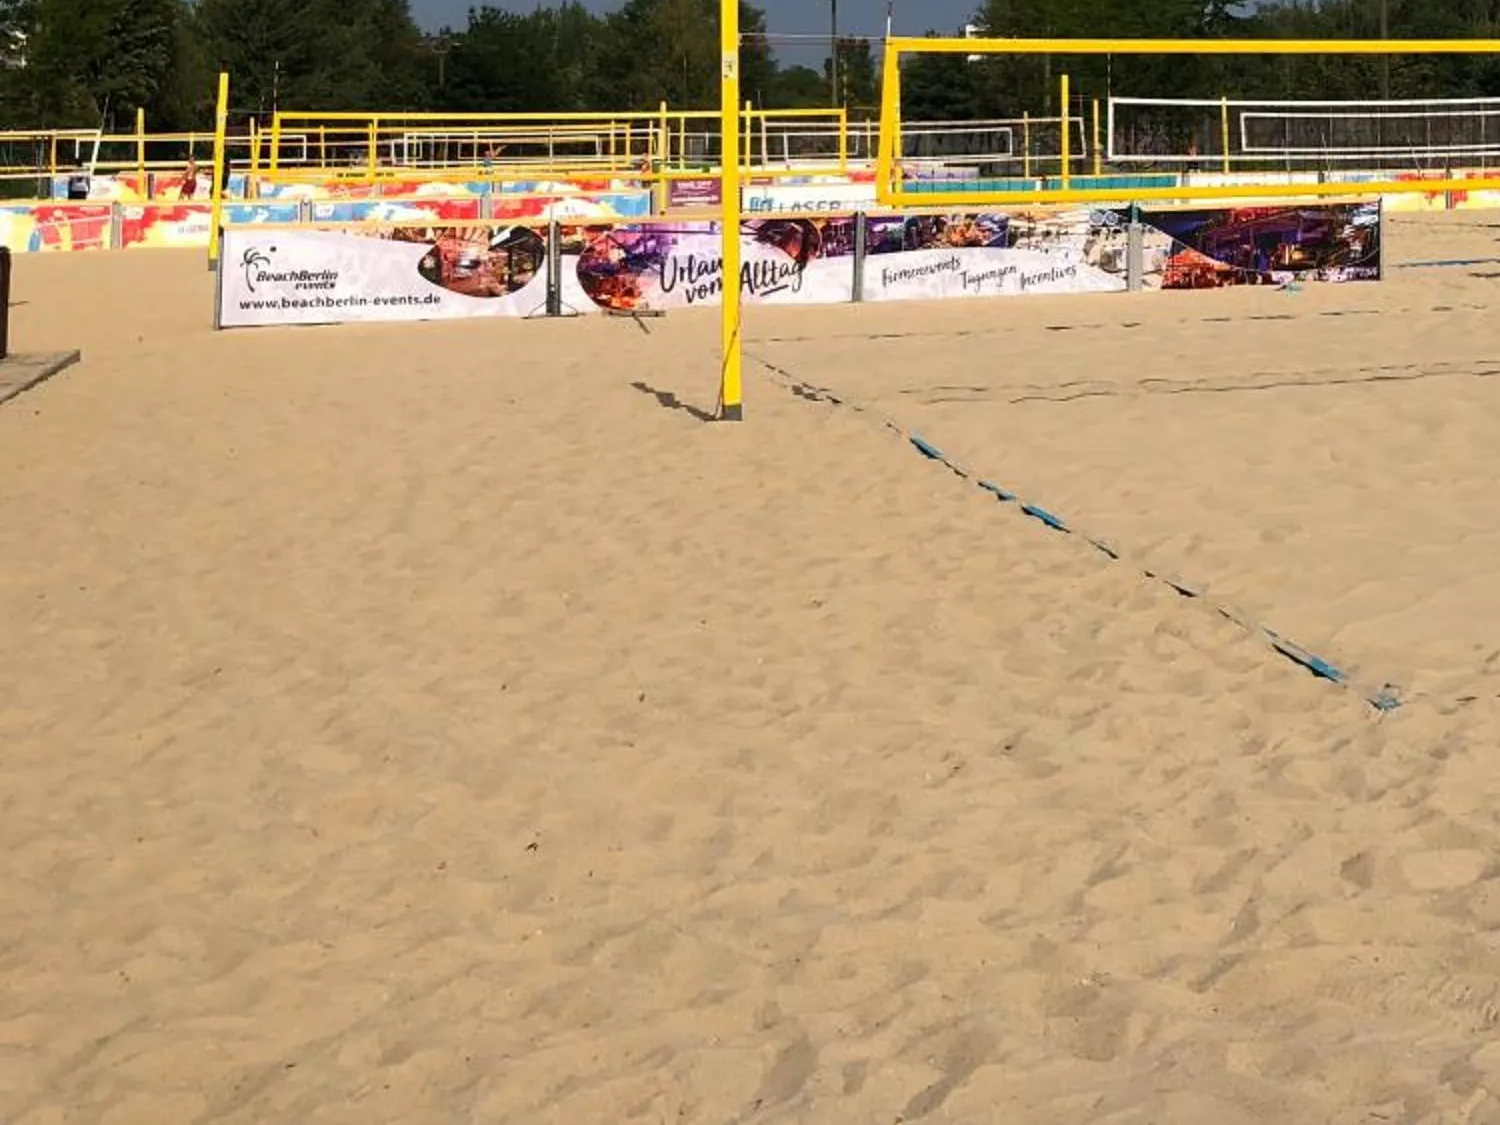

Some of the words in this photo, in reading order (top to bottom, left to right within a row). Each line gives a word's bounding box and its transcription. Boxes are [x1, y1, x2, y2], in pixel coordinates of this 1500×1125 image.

[660, 253, 724, 293] Urlau
[740, 259, 807, 295] Alltag
[239, 292, 441, 310] www.beachberlin-events.de
